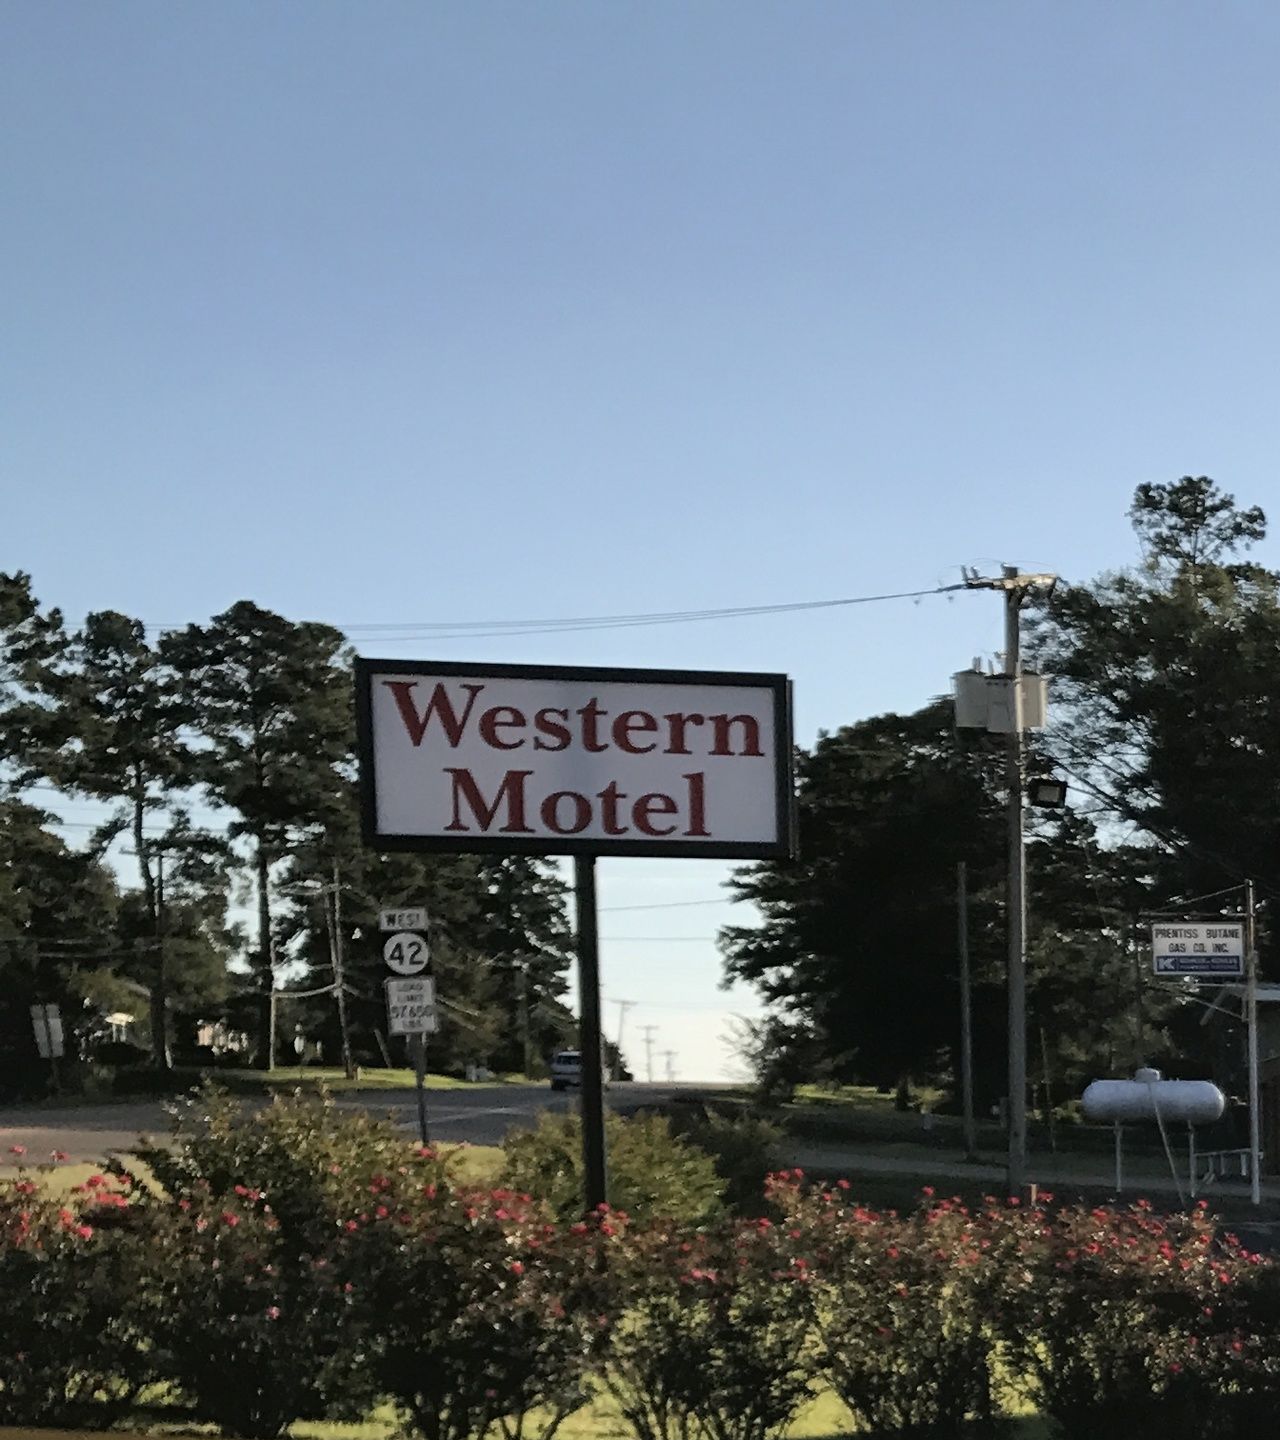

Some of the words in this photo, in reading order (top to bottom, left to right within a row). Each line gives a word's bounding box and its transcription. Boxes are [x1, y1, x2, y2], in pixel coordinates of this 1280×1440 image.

[382, 680, 765, 757] Western
[443, 767, 712, 837] Motel
[1154, 928, 1198, 939] PRENTISS
[1206, 928, 1240, 939] BUTANE
[389, 941, 425, 966] 42
[1168, 943, 1187, 953] GAS
